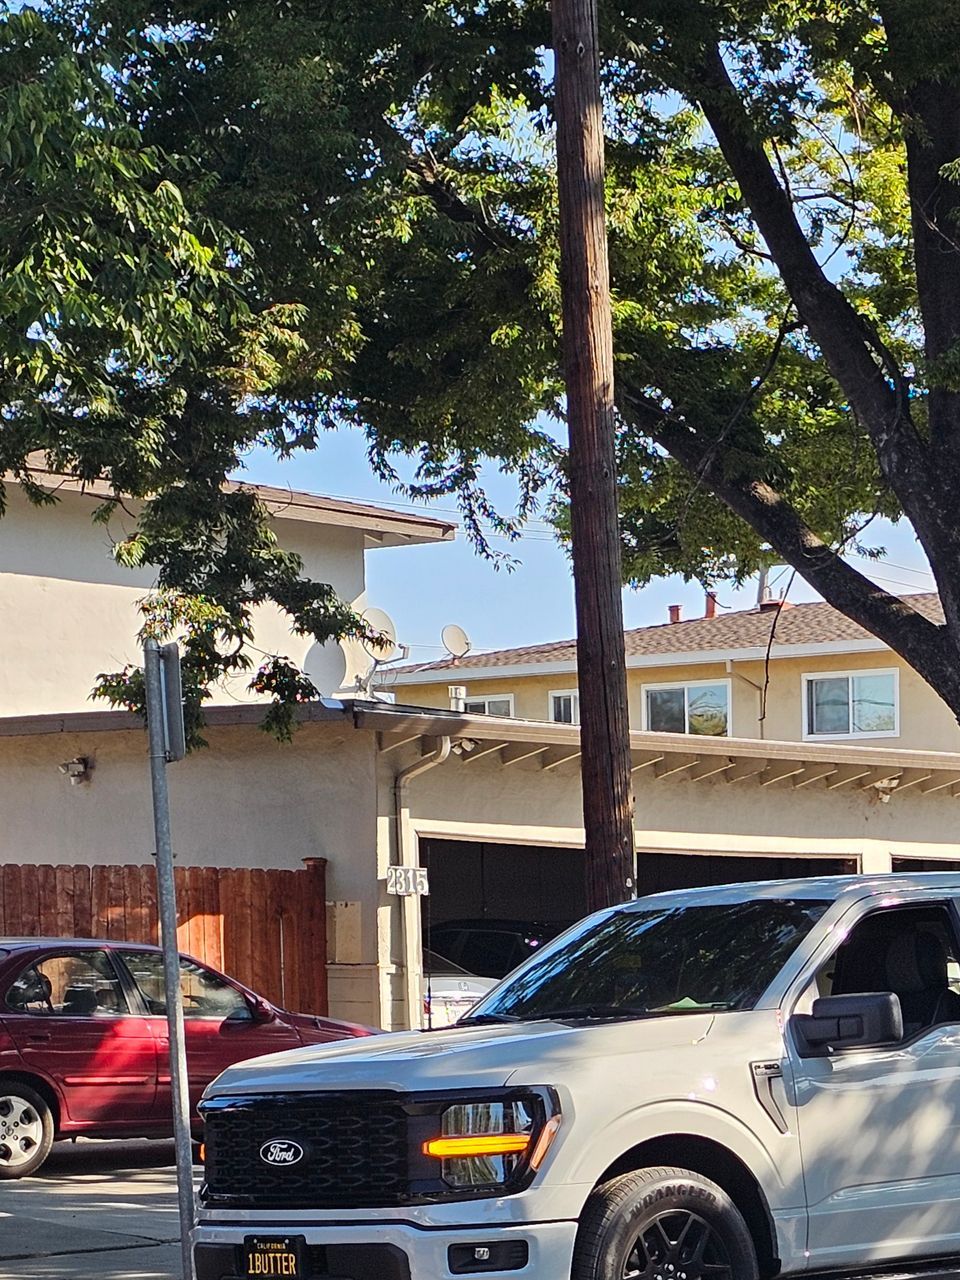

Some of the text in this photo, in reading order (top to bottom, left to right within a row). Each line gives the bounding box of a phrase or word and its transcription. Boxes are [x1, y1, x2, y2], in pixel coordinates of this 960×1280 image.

[387, 868, 429, 895] 2315
[267, 1143, 295, 1161] Ford
[627, 1184, 718, 1222] WRANGLER
[256, 1242, 286, 1250] CALIFORNIA
[248, 1253, 297, 1275] 1BUTTER
